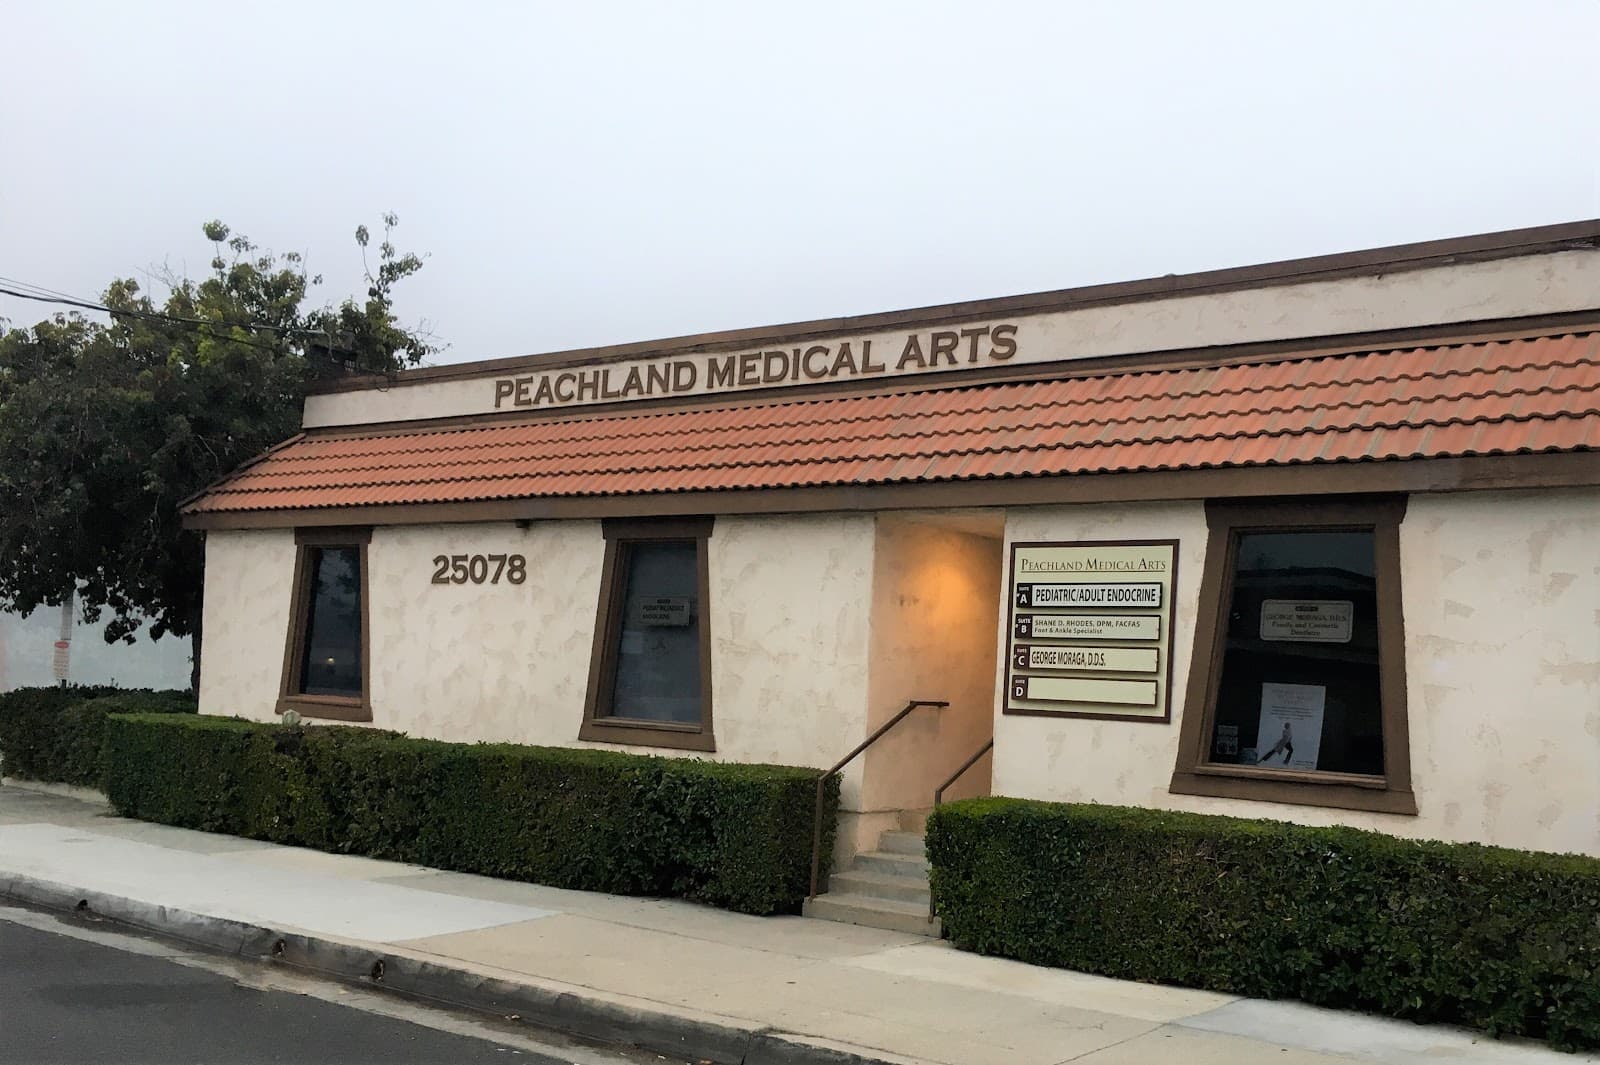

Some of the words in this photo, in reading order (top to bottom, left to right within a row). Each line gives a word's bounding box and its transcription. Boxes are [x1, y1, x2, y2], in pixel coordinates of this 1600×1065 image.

[494, 360, 697, 409] PEACHLAND
[706, 340, 886, 389] MEDICAL
[895, 323, 1019, 371] ARTS
[431, 553, 527, 585] 25078
[1019, 593, 1028, 604] A
[1035, 588, 1106, 602] PEDIATRIC/ADULT
[1107, 588, 1157, 602] ENDOCRINE
[1020, 624, 1028, 634] B
[1035, 619, 1057, 627] SHANE
[1066, 620, 1095, 628] RHODES,
[1096, 620, 1114, 628] DPM,
[1018, 655, 1026, 666] C
[1031, 651, 1057, 665] GEORGE
[1057, 652, 1087, 667] MORAGA,
[1087, 652, 1106, 667] D.D.S.
[1015, 686, 1024, 697] D
